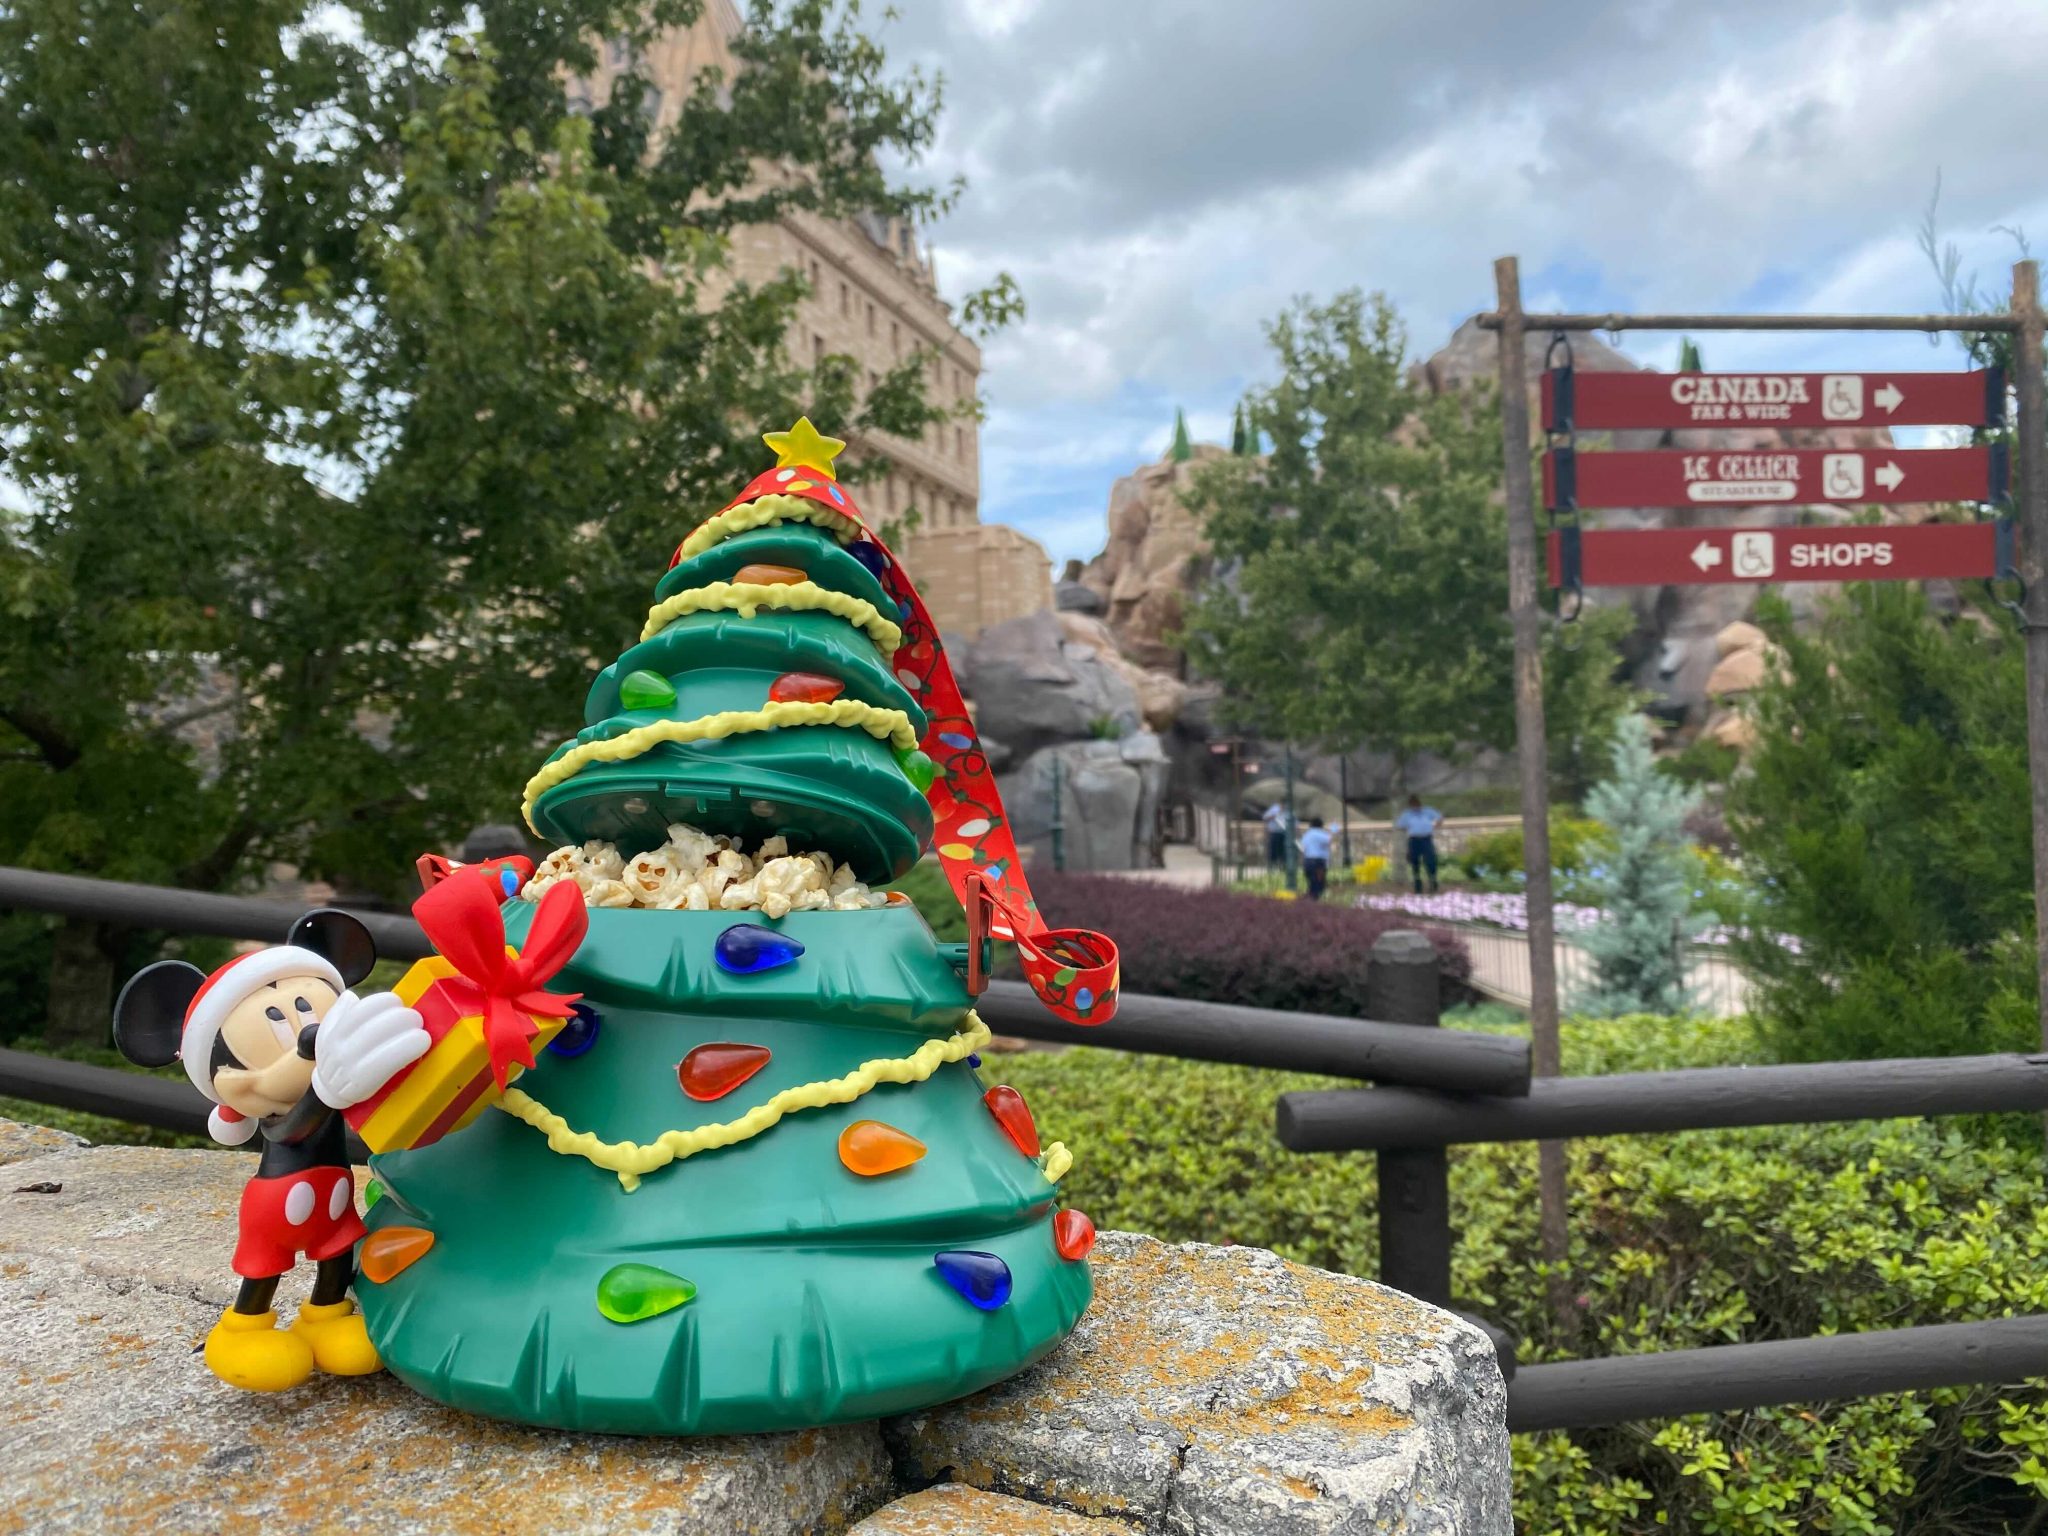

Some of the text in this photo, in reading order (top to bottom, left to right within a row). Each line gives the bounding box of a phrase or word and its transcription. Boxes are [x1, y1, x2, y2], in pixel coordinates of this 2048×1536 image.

[1671, 376, 1810, 404] CANADA
[1691, 404, 1792, 420] FAR & WIDE
[1682, 454, 1801, 481] LE CELLIER
[1790, 542, 1893, 568] SHOPS
